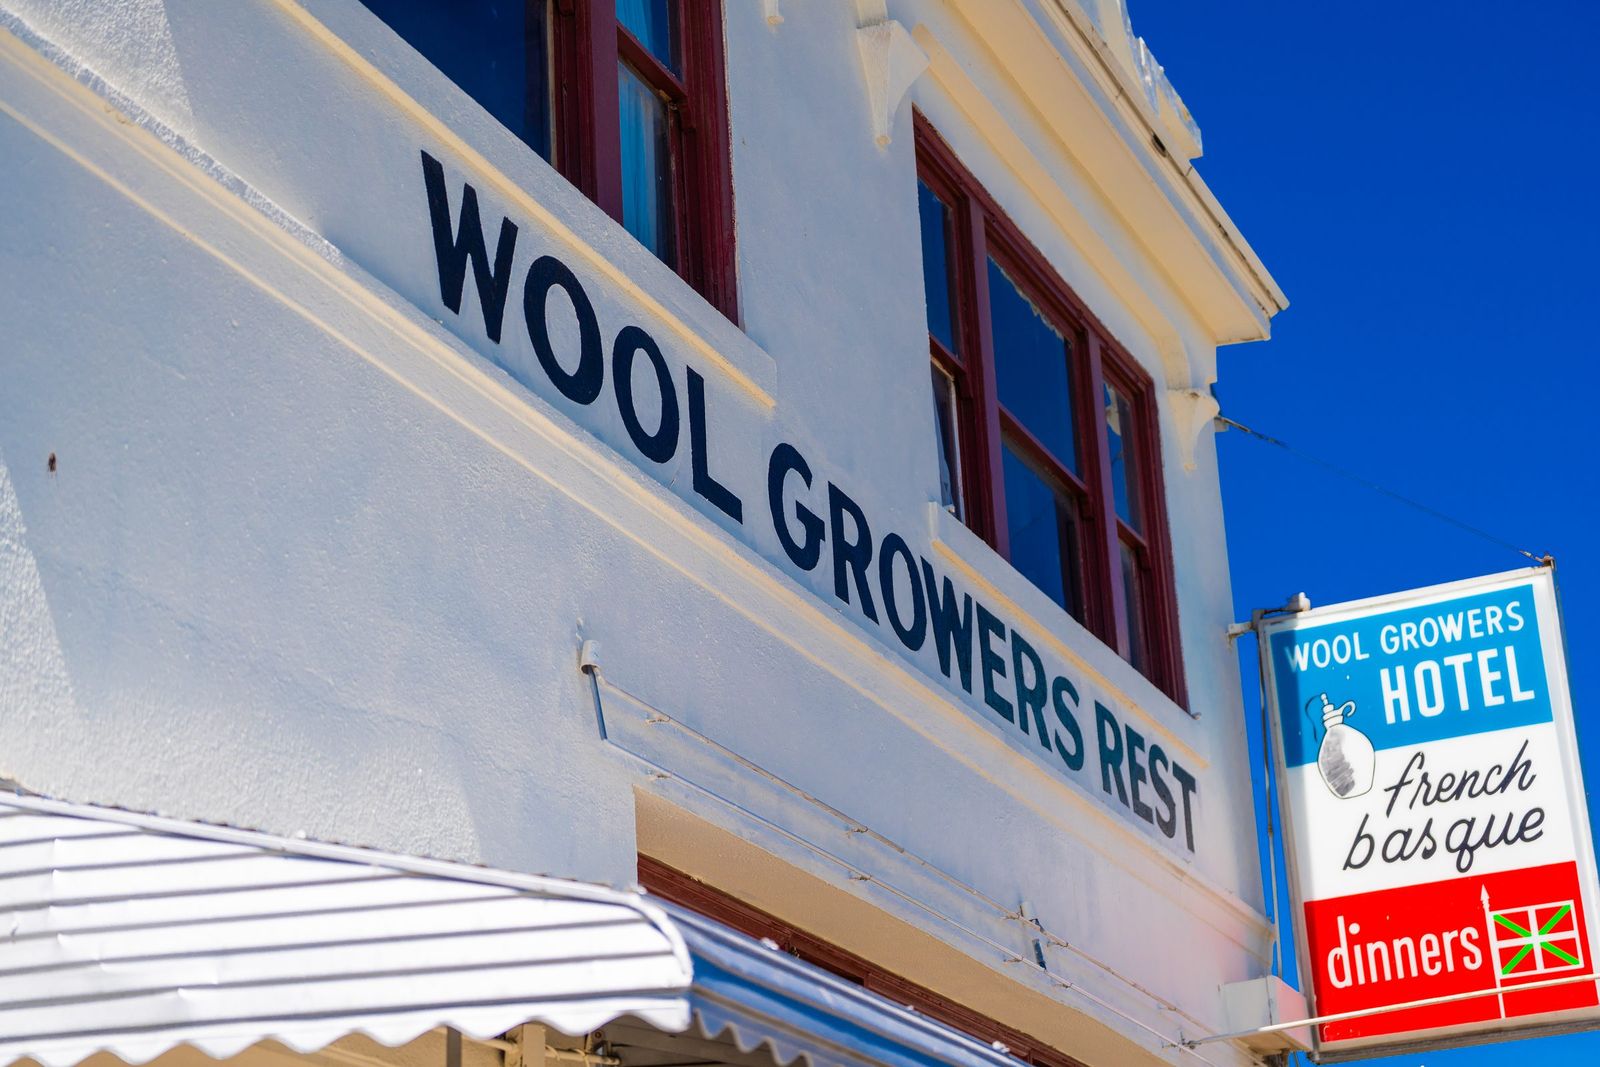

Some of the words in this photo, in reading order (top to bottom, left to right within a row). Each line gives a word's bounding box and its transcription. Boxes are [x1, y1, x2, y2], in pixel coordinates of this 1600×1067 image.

[421, 150, 743, 525] WOOL
[768, 442, 1085, 772] GROWERS
[1095, 700, 1196, 853] REST
[1285, 632, 1369, 673] WOOL
[1381, 601, 1524, 654] GROWERS
[1380, 645, 1535, 724] HOTEL
[1384, 739, 1537, 818] french
[1342, 807, 1545, 873] basque
[1327, 915, 1482, 989] dinners
